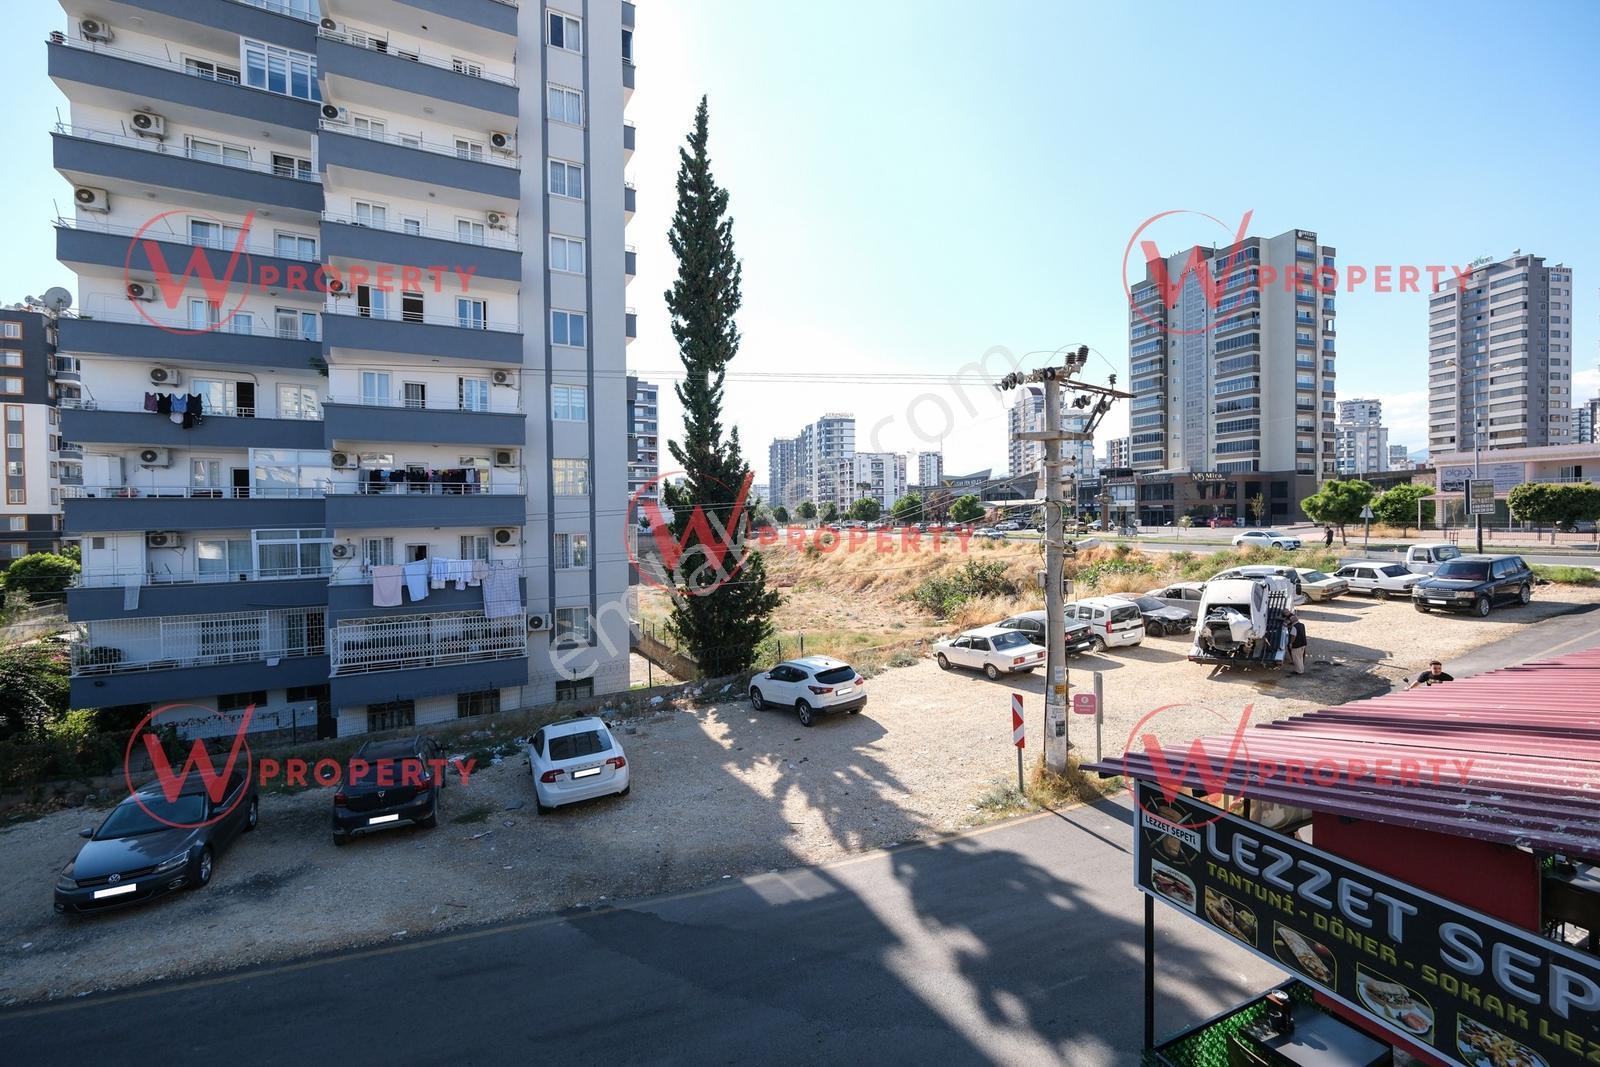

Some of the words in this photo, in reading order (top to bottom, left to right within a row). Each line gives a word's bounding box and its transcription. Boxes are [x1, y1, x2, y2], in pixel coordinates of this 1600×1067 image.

[1145, 814, 1170, 833] LEZZET
[1206, 820, 1418, 944] LEZZET
[1439, 922, 1600, 1020] SEP
[1206, 861, 1294, 916] TANTUNİ
[1313, 911, 1397, 966] DÖNER
[1421, 964, 1529, 1030] SOKAK
